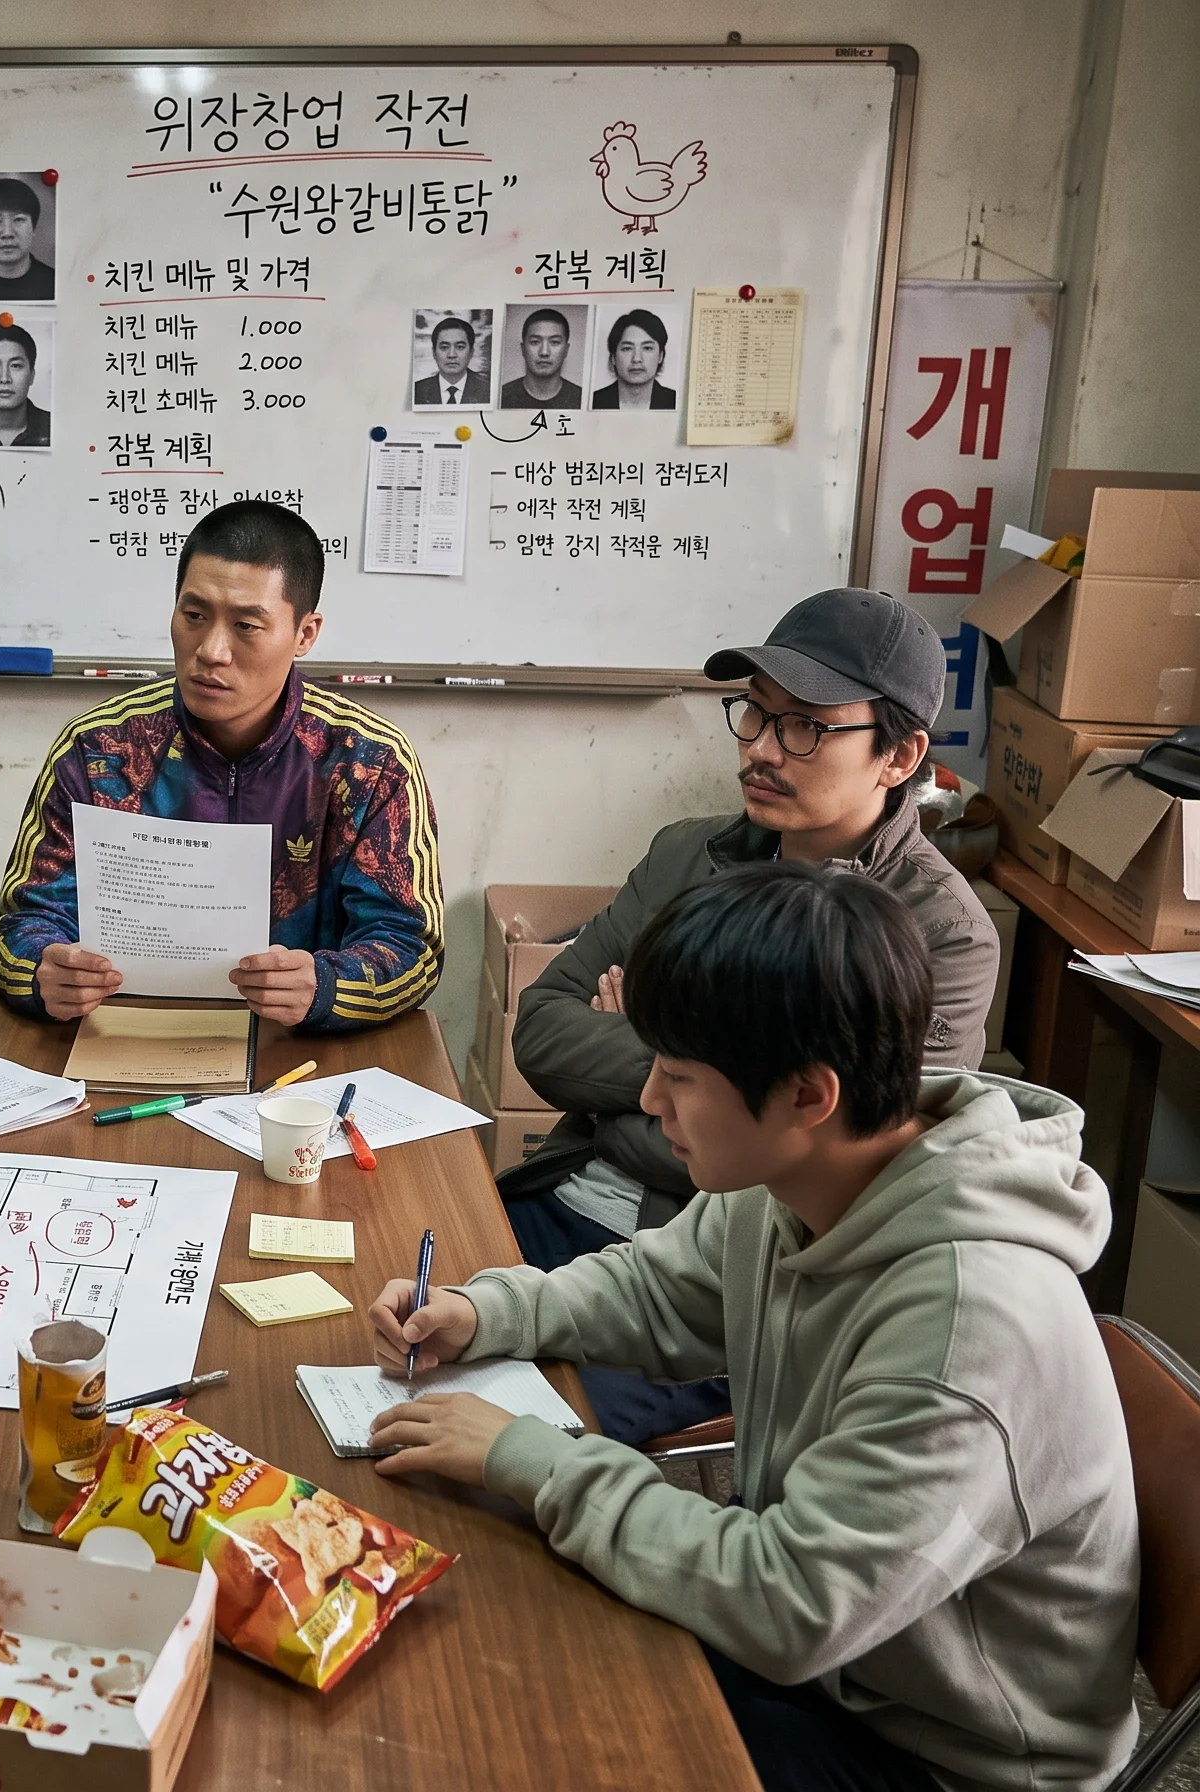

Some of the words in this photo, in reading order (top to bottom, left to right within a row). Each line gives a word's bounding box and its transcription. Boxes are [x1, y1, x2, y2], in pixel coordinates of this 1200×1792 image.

[145, 90, 347, 154] 위장창업
[374, 89, 470, 151] 작전
[105, 259, 155, 293] 치킨
[165, 259, 216, 293] 메뉴
[227, 256, 249, 292] 및
[260, 256, 310, 293] 가격
[535, 249, 592, 290] 잠복
[605, 247, 666, 289] 계획
[104, 313, 147, 341] 치킨
[155, 313, 199, 341] 메뉴
[241, 315, 302, 337] 1.000
[105, 350, 147, 377] 치킨
[155, 350, 199, 377] 메뉴
[238, 352, 303, 372] 2.000
[106, 387, 148, 414] 치킨
[156, 387, 218, 414] 초메뉴
[242, 389, 306, 411] 3.000
[107, 433, 155, 468] 잠복
[163, 432, 212, 468] 계획
[514, 460, 557, 487] 대상
[565, 460, 644, 486] 범죄자의
[901, 347, 1012, 594] 개업
[567, 497, 601, 521] 작전
[564, 534, 600, 558] 강지
